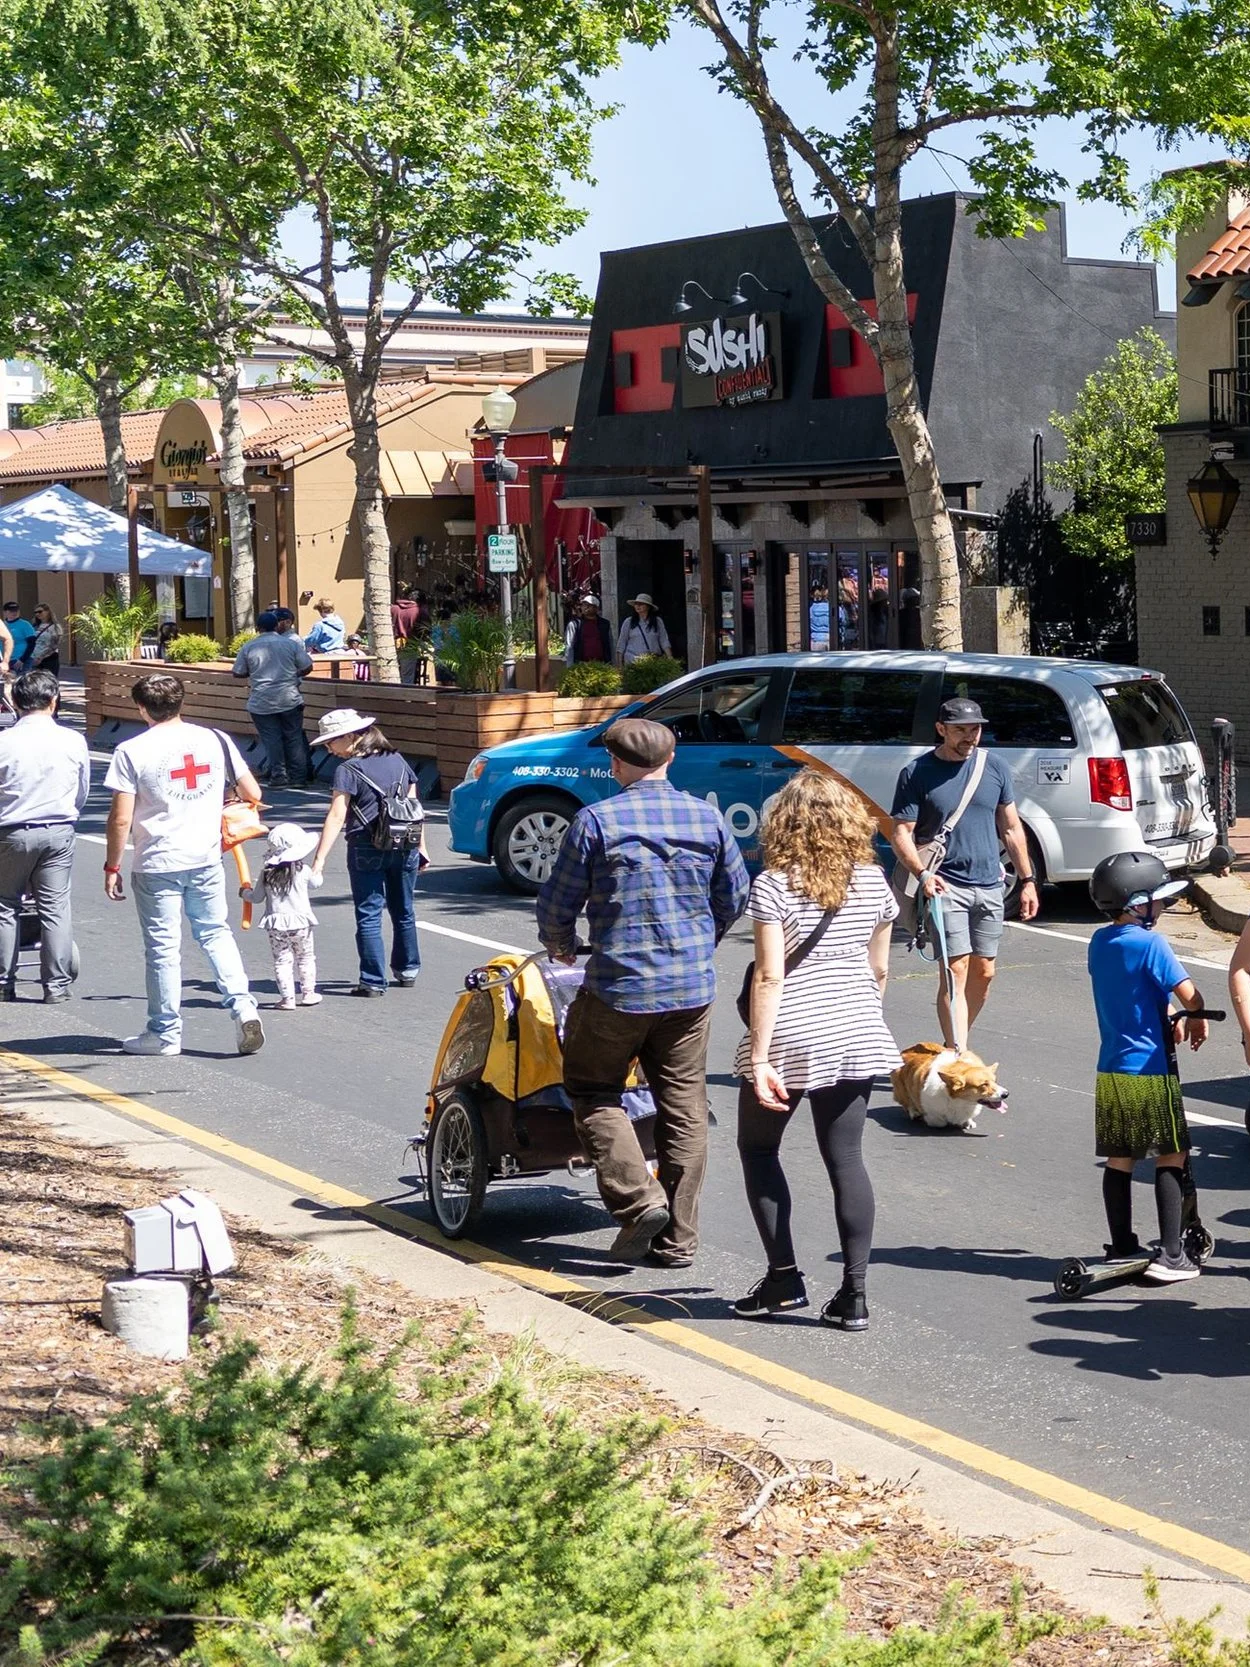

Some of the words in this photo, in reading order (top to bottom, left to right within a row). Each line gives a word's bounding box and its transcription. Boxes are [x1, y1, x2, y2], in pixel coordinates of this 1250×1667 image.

[684, 313, 765, 374] SUSHI
[160, 439, 208, 480] Giorgio's
[512, 766, 580, 778] 408-330-3302
